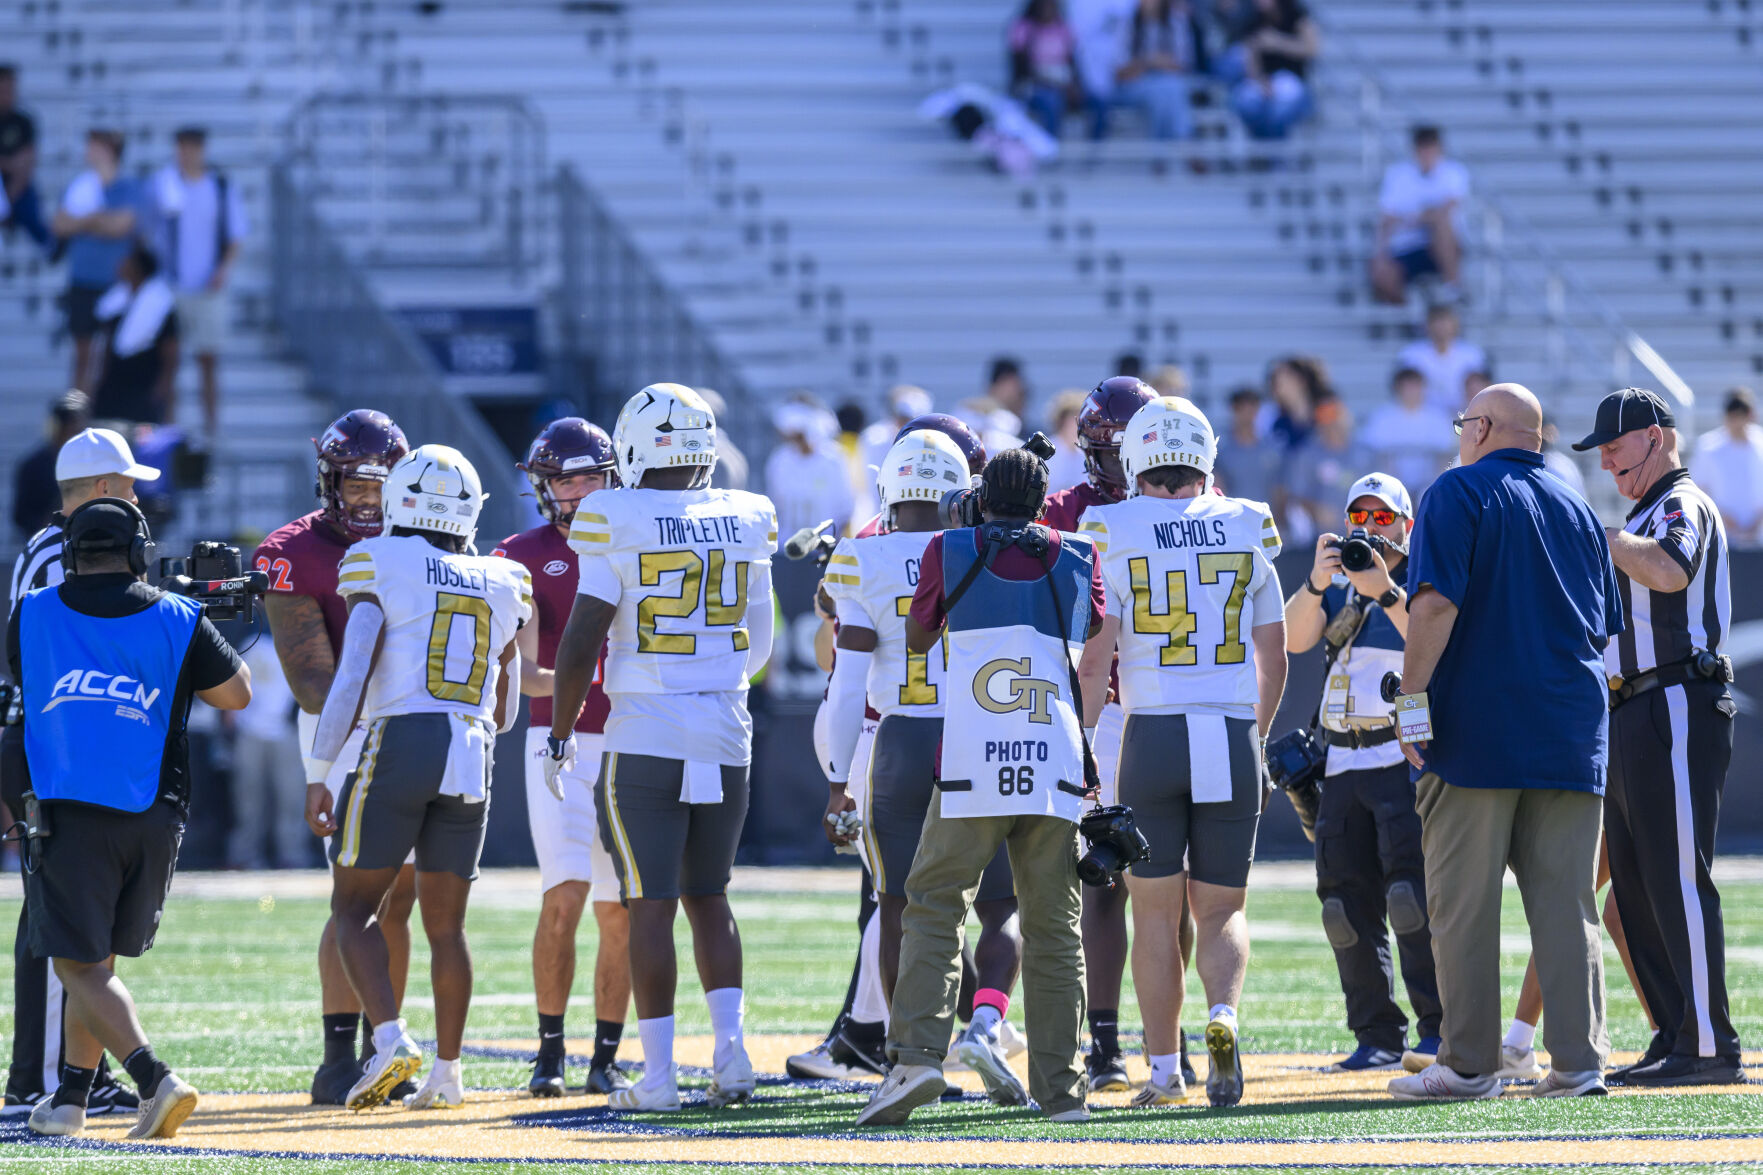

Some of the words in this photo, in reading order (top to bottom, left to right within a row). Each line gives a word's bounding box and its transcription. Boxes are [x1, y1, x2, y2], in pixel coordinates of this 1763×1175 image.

[1163, 419, 1180, 429] 47
[921, 450, 936, 462] 14
[1148, 452, 1200, 466] JACKETS
[900, 488, 945, 499] JACKE
[411, 516, 462, 533] JACKETS
[654, 515, 742, 545] TRIPLETTE
[1153, 519, 1227, 549] NICHOLS
[221, 581, 244, 591] RONIN
[425, 557, 488, 592] HOSLEY
[637, 548, 750, 655] 24
[1128, 552, 1254, 667] 47
[426, 591, 494, 706] 0
[895, 596, 949, 705] 1
[50, 669, 160, 711] ACCN
[972, 657, 1060, 725] GT
[115, 704, 150, 726] ESPN
[1402, 723, 1430, 736] PRE-GAME
[985, 740, 1048, 762] PHOTO
[998, 765, 1034, 796] 86
